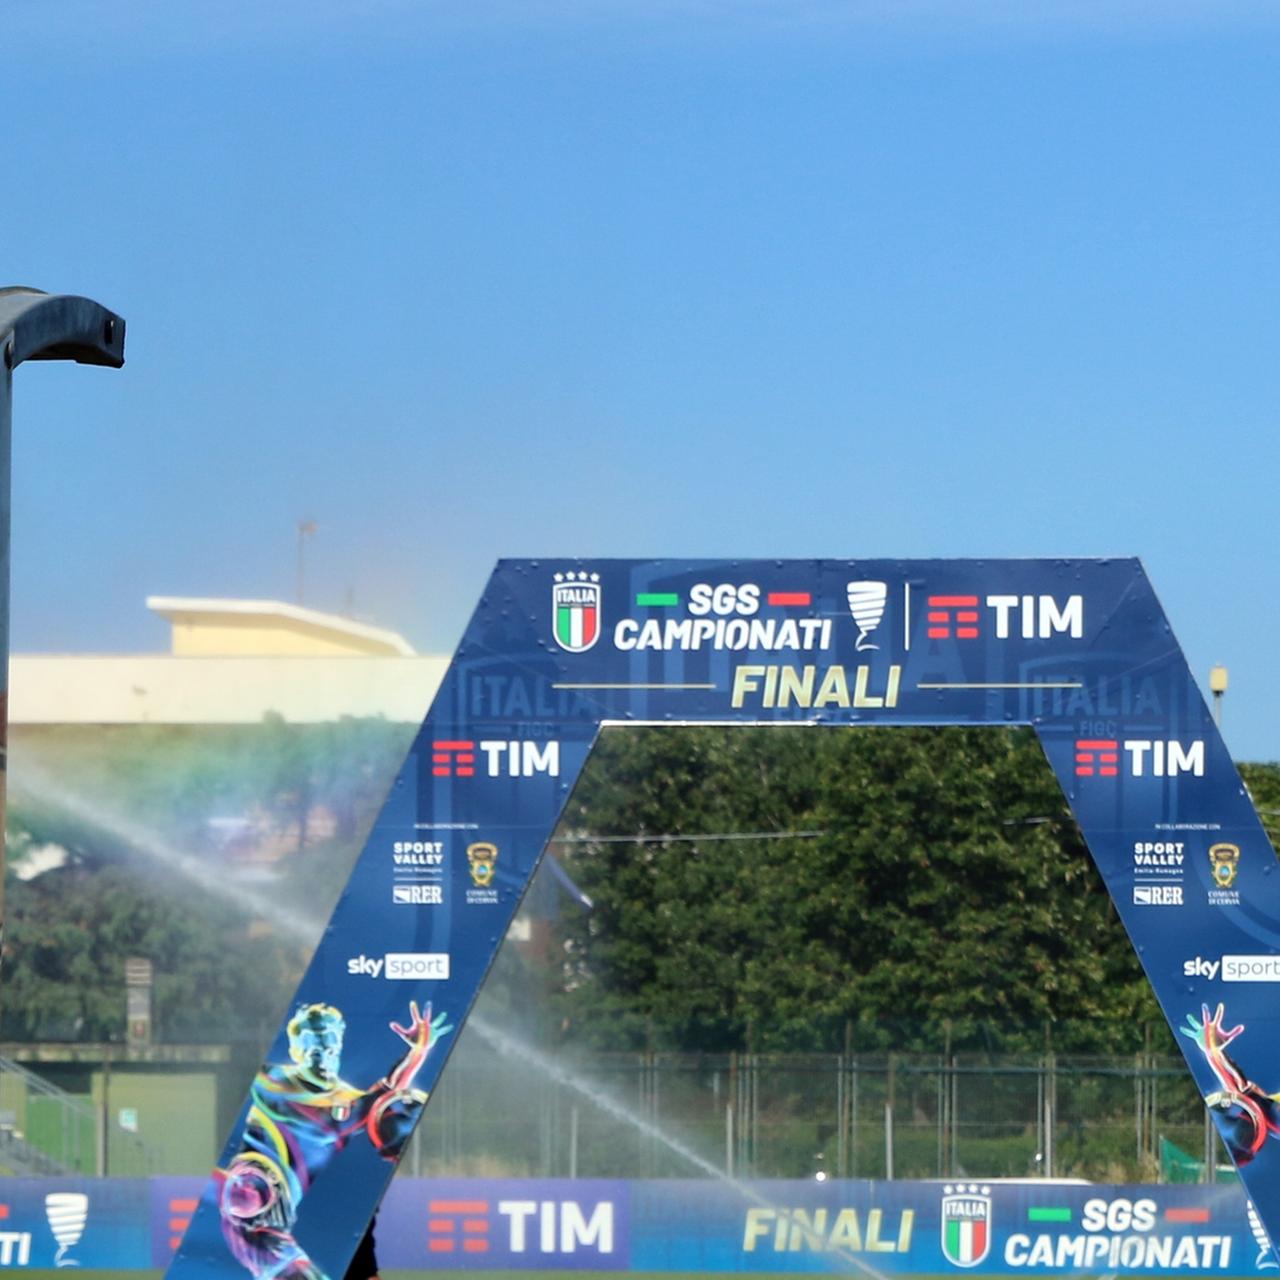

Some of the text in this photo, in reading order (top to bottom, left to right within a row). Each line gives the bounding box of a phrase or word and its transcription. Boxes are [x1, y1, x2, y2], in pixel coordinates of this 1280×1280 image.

[557, 589, 596, 602] ITALIA
[688, 584, 760, 615] SGS
[987, 596, 1083, 638] TIM
[613, 619, 832, 650] CAMPIONATI
[731, 665, 901, 708] FINALI
[480, 741, 559, 776] TIM
[1125, 741, 1204, 776] TIM
[393, 842, 443, 853] SPORT
[393, 854, 443, 865] VALLEY
[1134, 843, 1184, 854] SPORT
[1134, 855, 1184, 865] VALLEY
[411, 886, 443, 904] RER
[1151, 887, 1184, 905] RER
[347, 955, 443, 978] sky sport
[1183, 956, 1280, 980] sky sport
[946, 1202, 985, 1216] ITALIA
[1082, 1199, 1156, 1232] SGS
[498, 1201, 613, 1252] TIM
[743, 1209, 914, 1252] FINALI
[1004, 1235, 1231, 1268] CAMPIONATI
